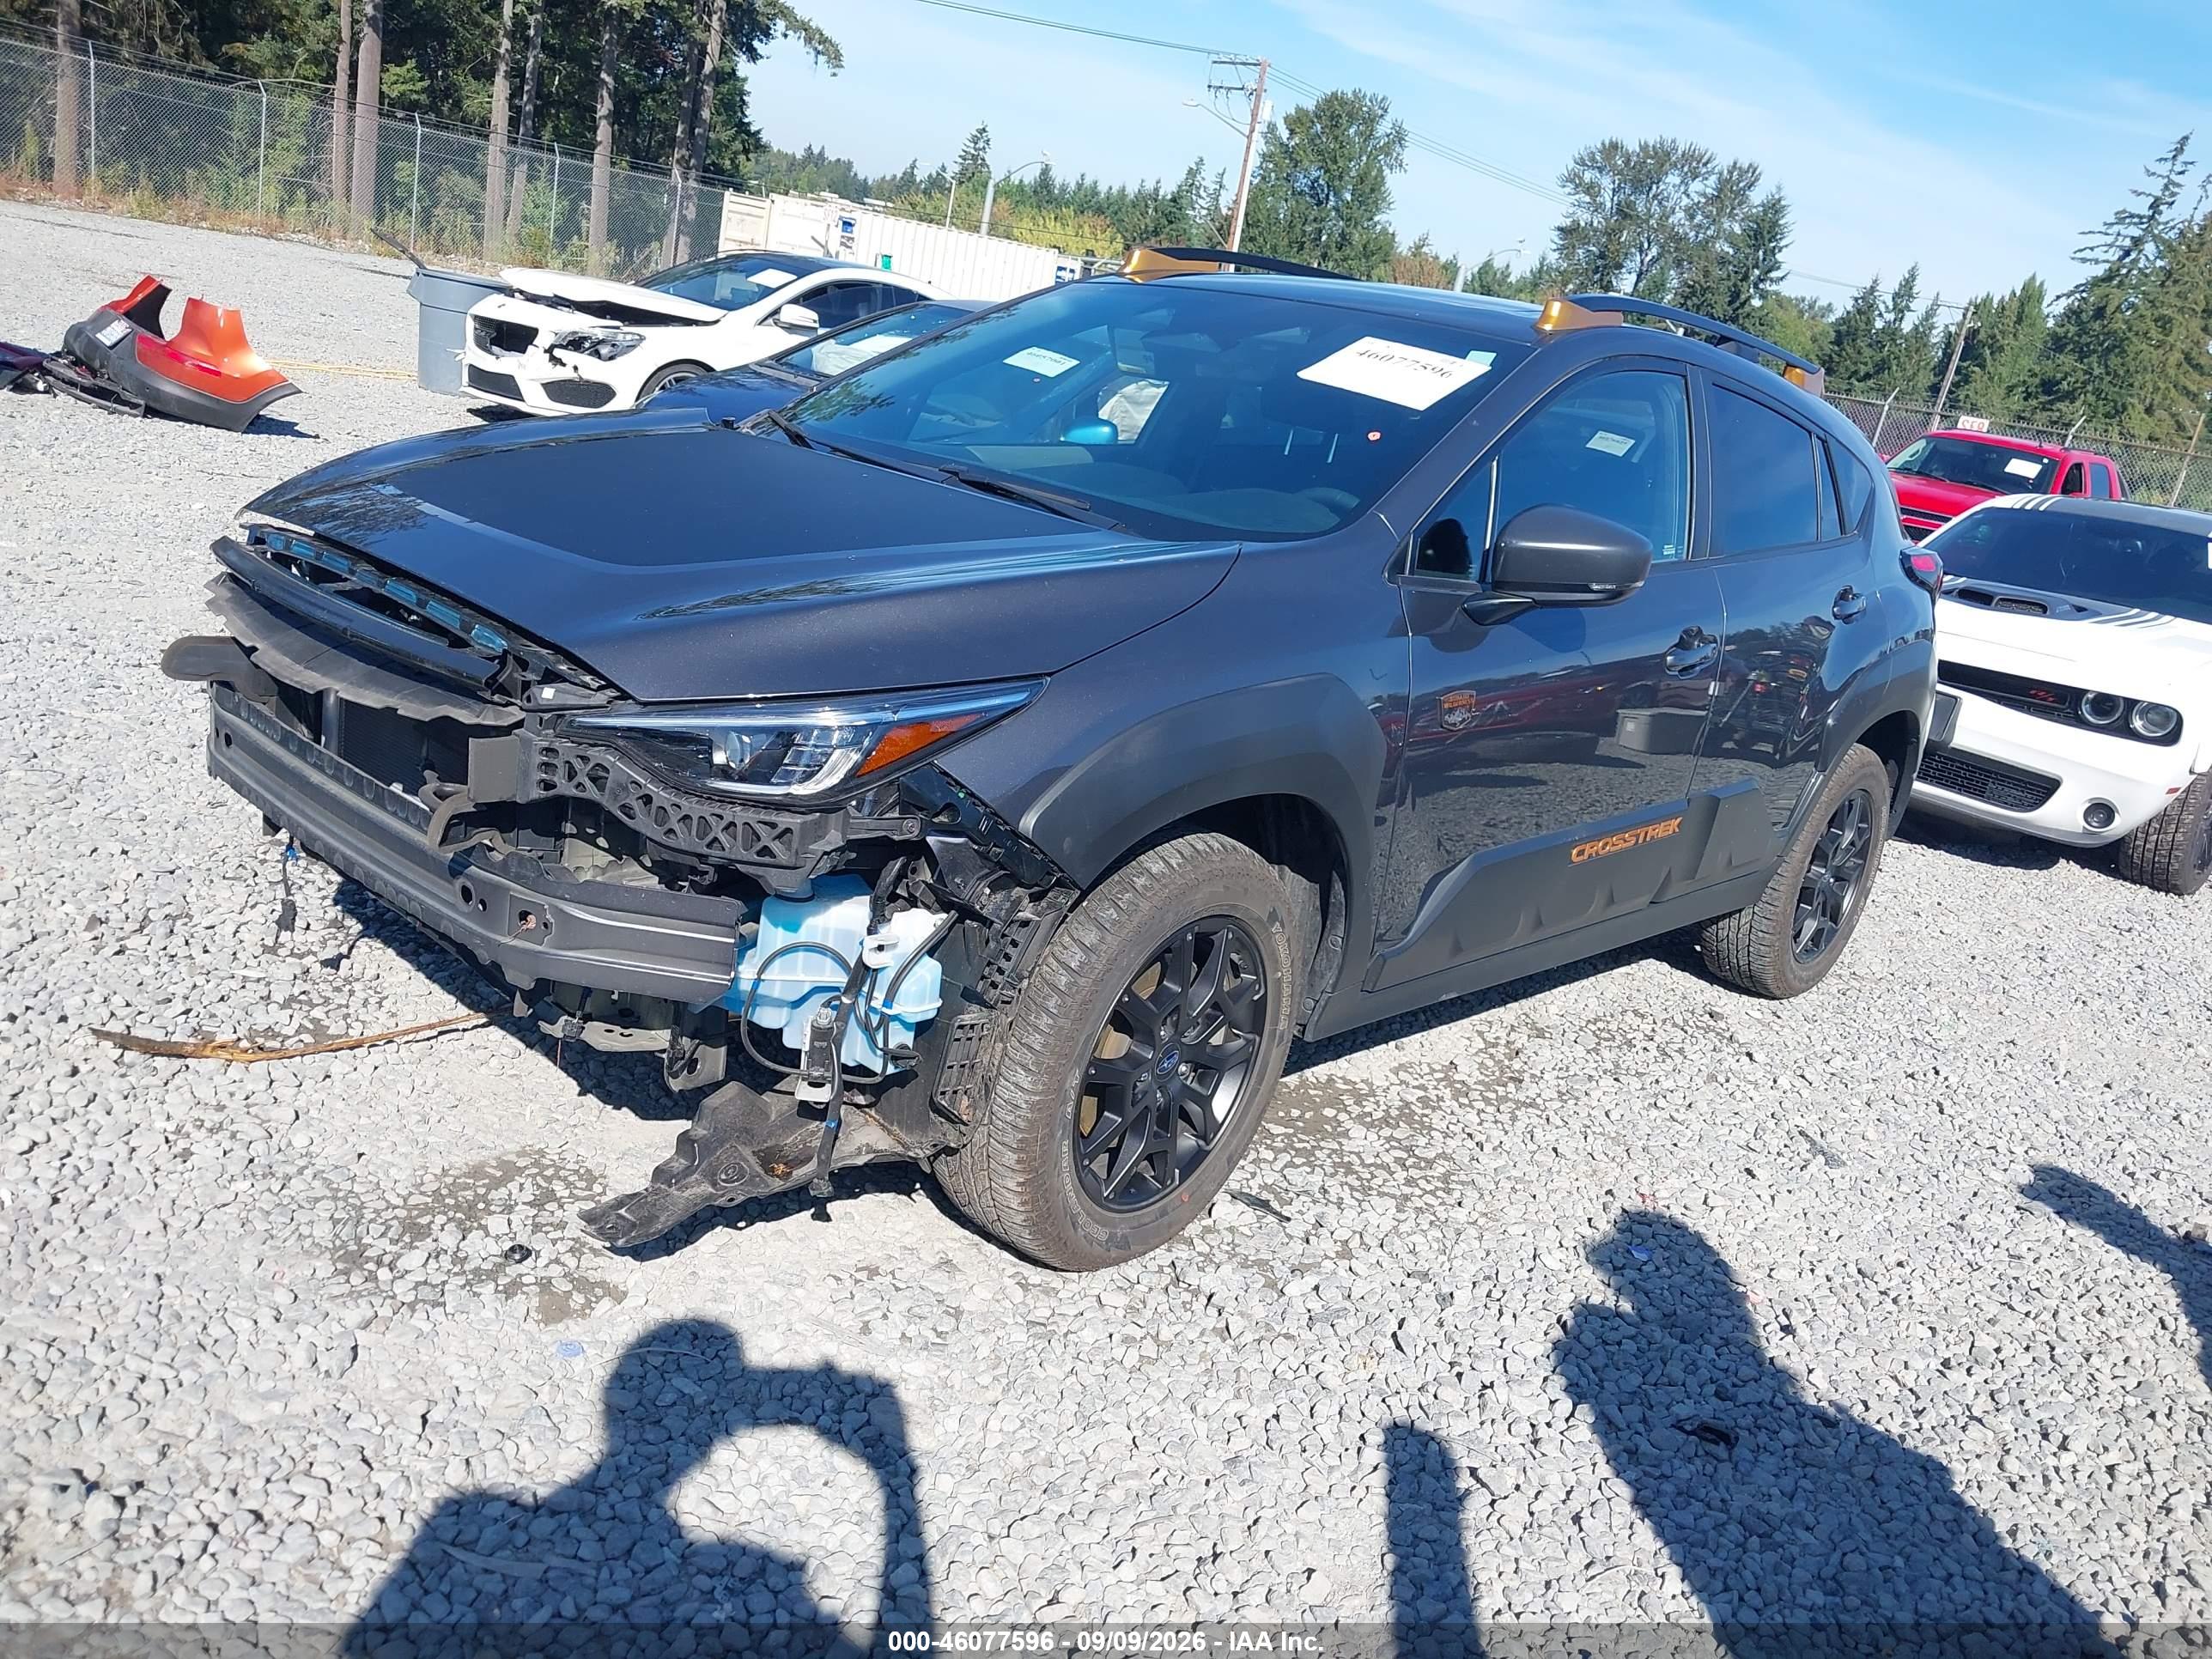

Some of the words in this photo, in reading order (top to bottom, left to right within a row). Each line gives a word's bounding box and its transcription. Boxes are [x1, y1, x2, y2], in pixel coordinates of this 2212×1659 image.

[1356, 348, 1454, 379] 46077596
[1570, 816, 1683, 864] CROSSTREK
[1271, 921, 1292, 1031] YOKOHAMA
[1061, 1139, 1109, 1242] GEOLANDAR
